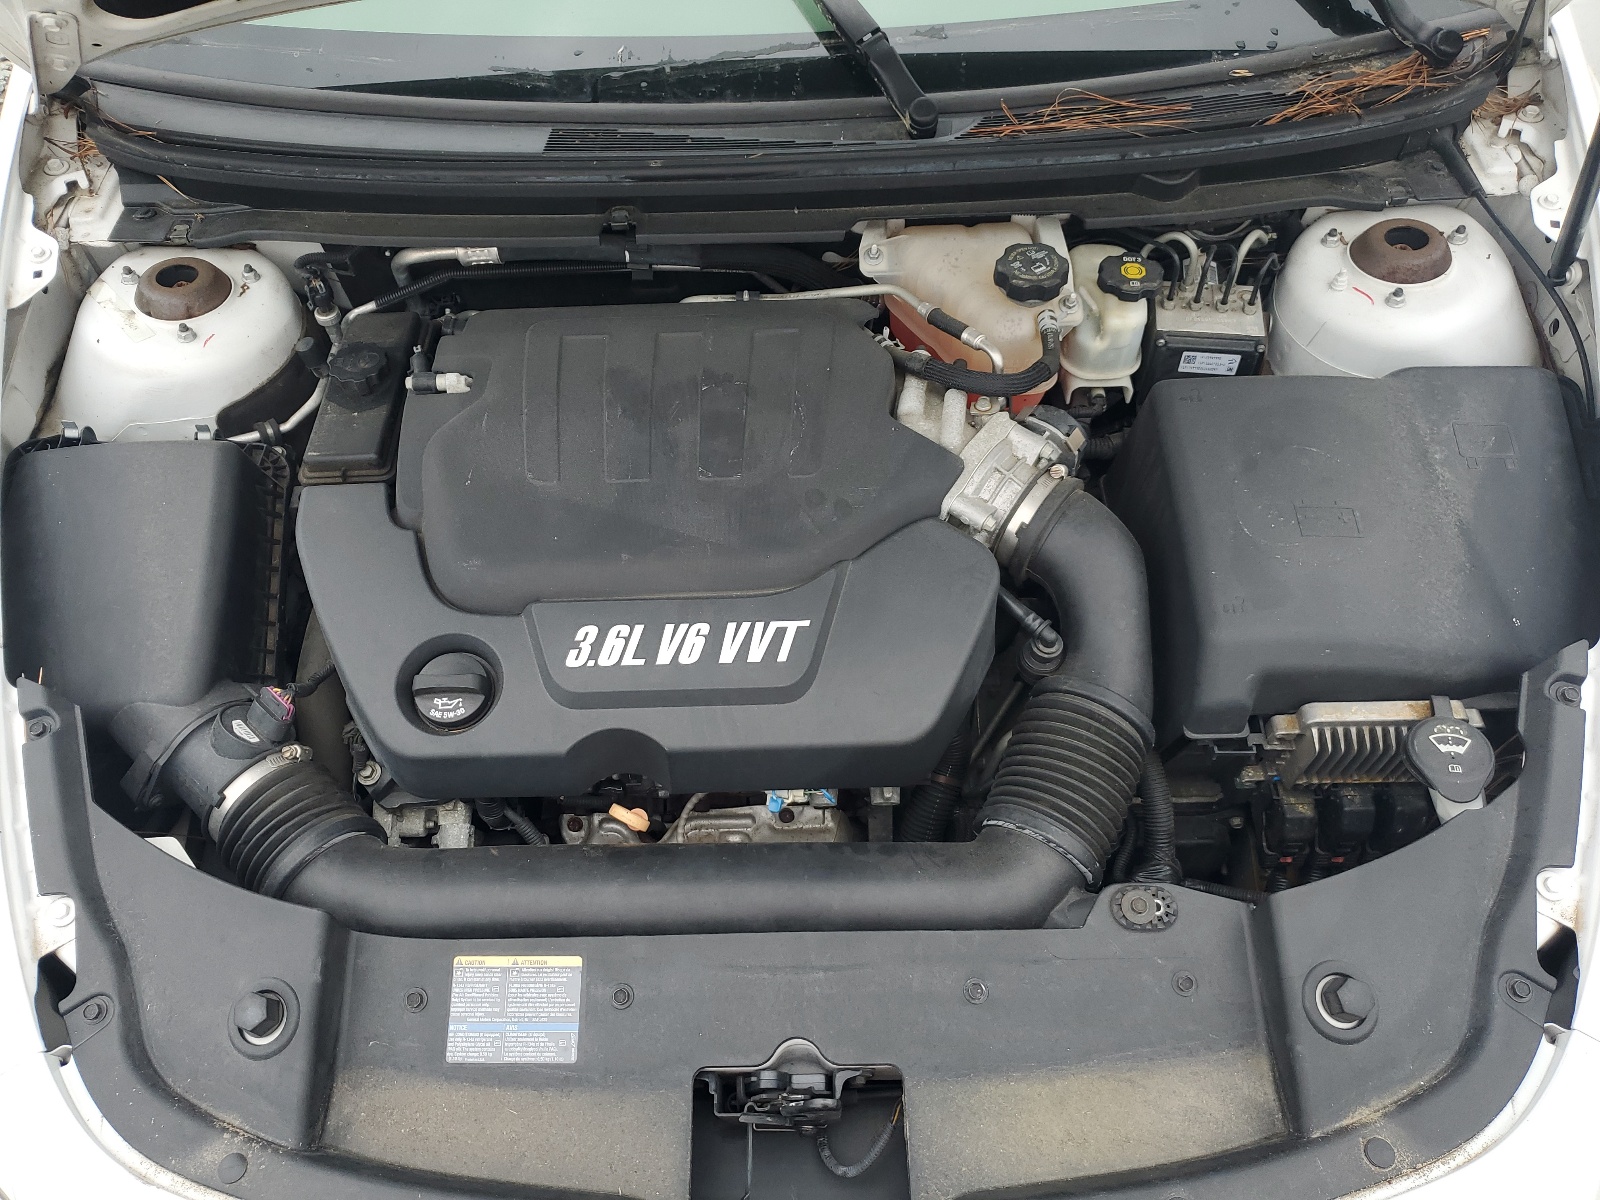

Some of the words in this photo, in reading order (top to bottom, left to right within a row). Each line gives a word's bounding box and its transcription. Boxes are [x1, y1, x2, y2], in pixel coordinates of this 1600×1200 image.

[565, 624, 646, 668] 3.6L
[655, 622, 710, 665] V6
[718, 619, 811, 664] VVT
[429, 708, 443, 718] SAE
[443, 707, 466, 719] 5W-30
